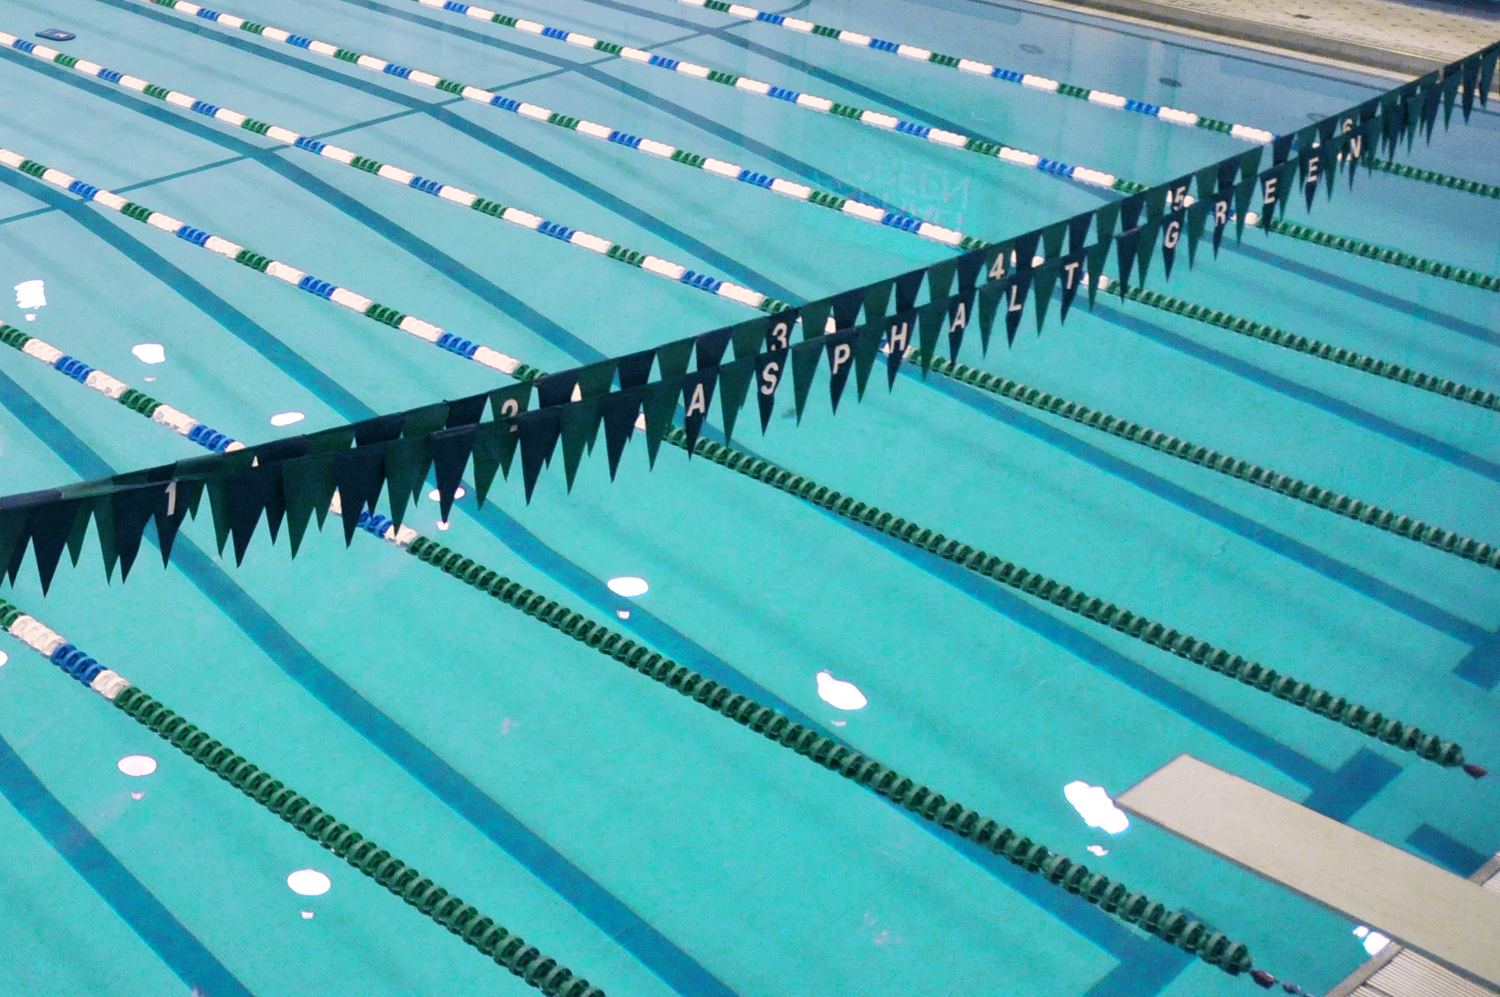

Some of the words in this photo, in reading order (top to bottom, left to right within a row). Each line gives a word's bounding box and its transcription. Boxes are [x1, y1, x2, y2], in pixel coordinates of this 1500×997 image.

[1174, 186, 1186, 210] 5
[989, 252, 1005, 280] 4
[771, 323, 788, 352] 3
[165, 481, 177, 516] 1
